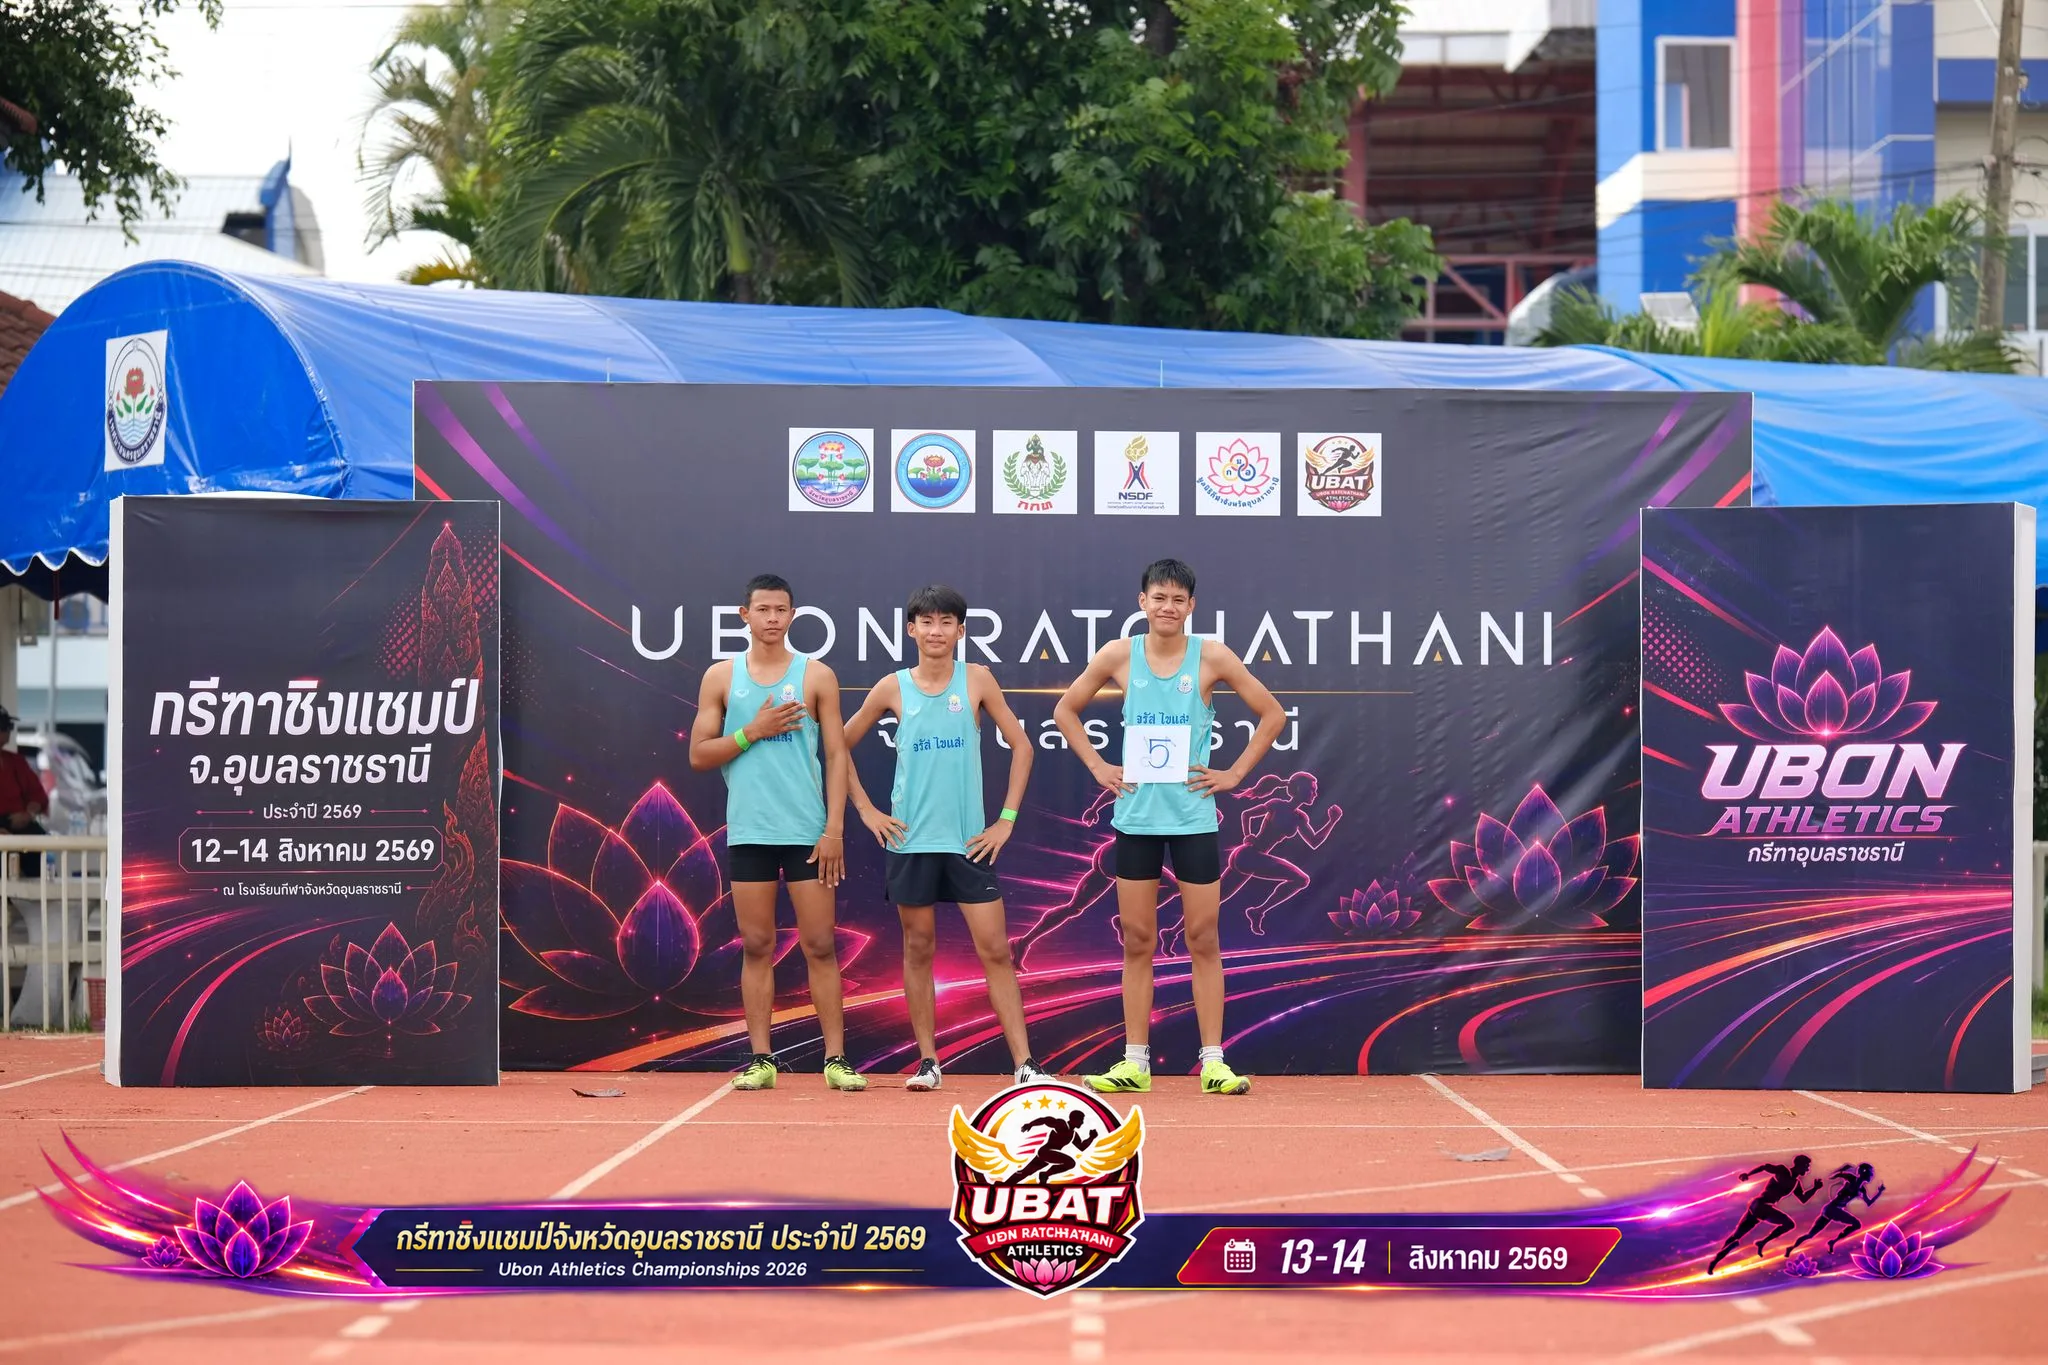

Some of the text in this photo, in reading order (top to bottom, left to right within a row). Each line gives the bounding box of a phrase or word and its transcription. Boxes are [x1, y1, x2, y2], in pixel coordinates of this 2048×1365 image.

[1118, 492, 1153, 500] NSDF
[1311, 475, 1369, 490] UBAT
[1017, 500, 1054, 511] กกท
[631, 605, 903, 661] UBON
[150, 677, 480, 736] กรีฑาชิงแชมป์
[1148, 738, 1172, 769] 5
[190, 743, 432, 796] จ.อุบลราชธานี
[1701, 743, 1968, 800] UBON
[263, 802, 362, 819] ประจำปี 2569
[1696, 804, 1958, 836] ATHLETICS
[278, 837, 367, 862] สิงหาคม
[375, 839, 435, 862] 2569
[1747, 841, 1906, 868] กรีฑาอุบลราชธานี
[222, 881, 402, 899] ณ โรงเรียนกีฬาจังหวัดอุบลราชธานี
